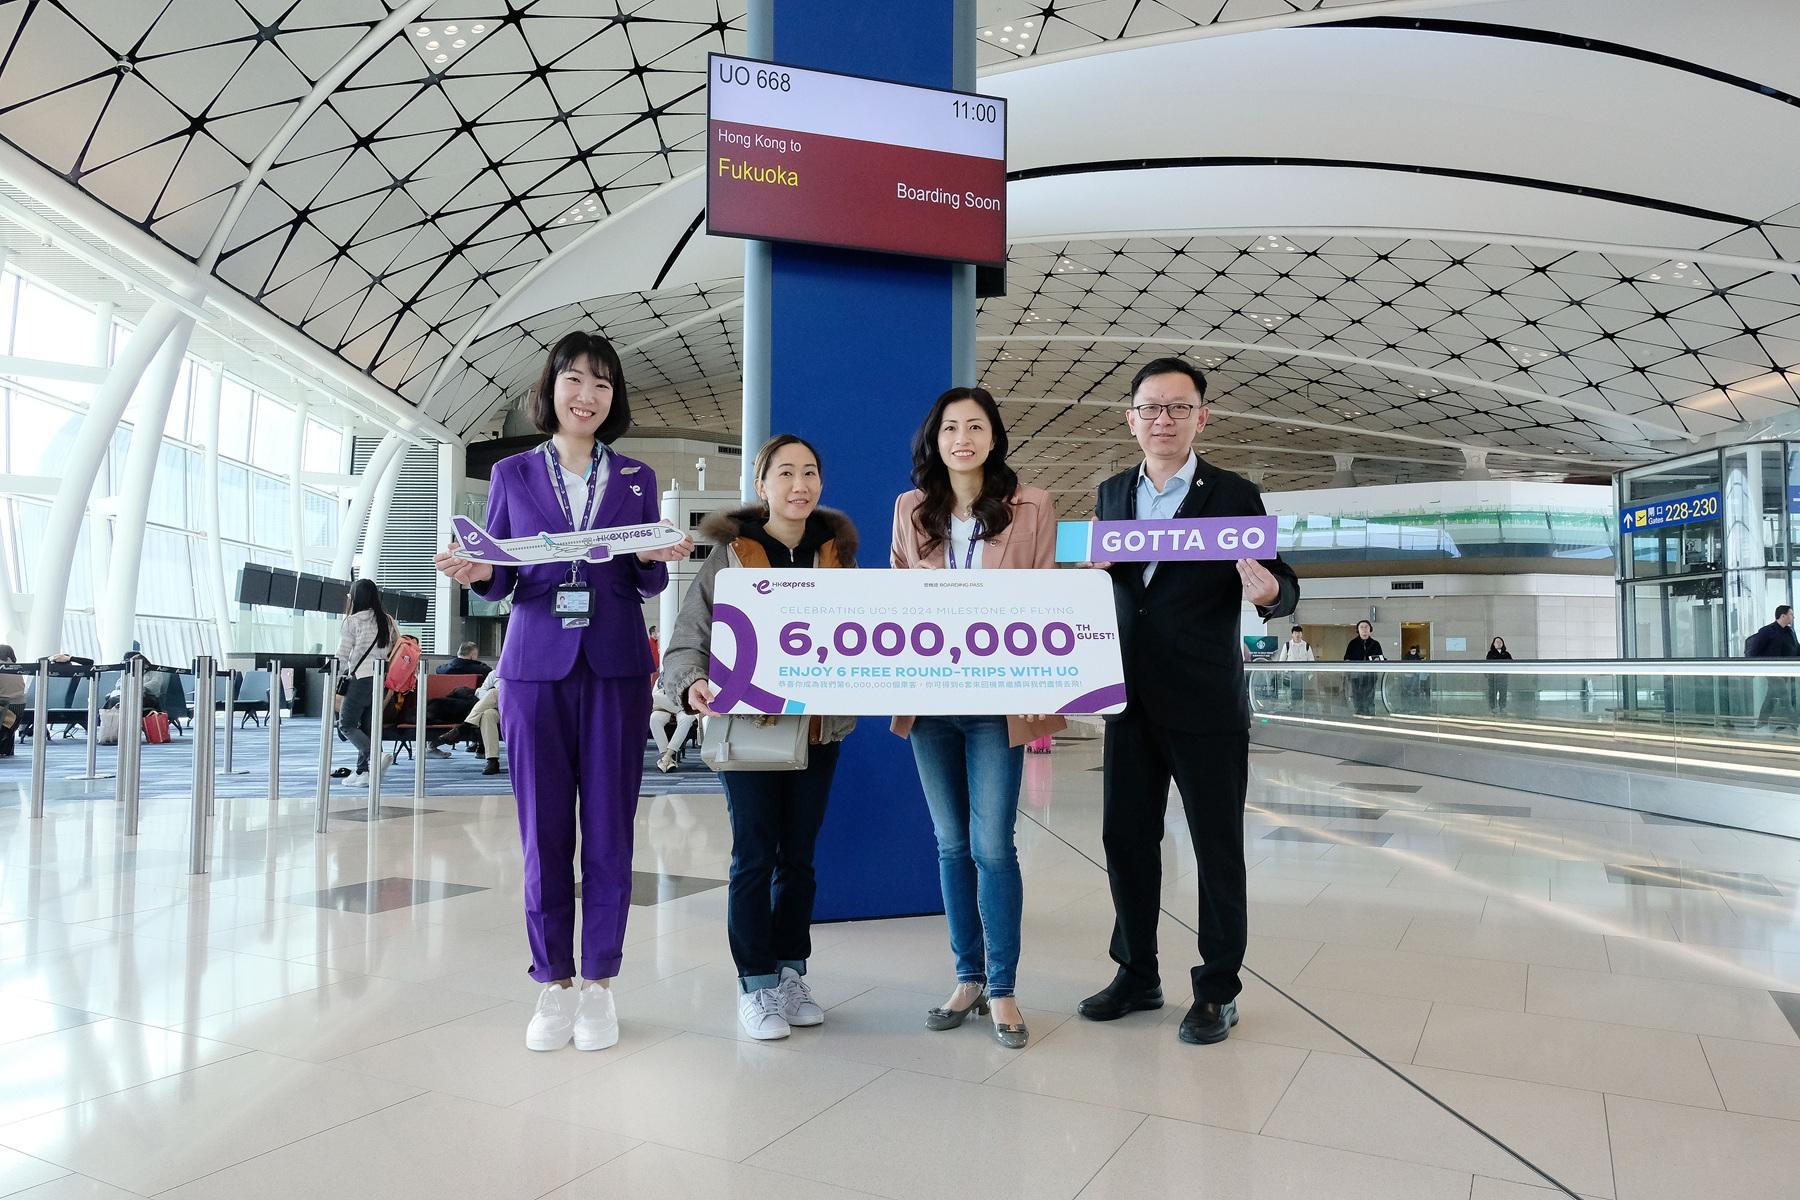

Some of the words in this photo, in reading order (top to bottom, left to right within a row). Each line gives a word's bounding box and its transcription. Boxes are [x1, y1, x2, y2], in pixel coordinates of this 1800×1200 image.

[719, 63, 750, 86] UO
[757, 69, 791, 92] 668
[952, 99, 997, 124] 11:00
[718, 128, 751, 149] Hong
[755, 133, 787, 154] Kong
[790, 139, 802, 153] to
[718, 157, 799, 187] Fukuoka
[897, 182, 960, 210] Boarding
[965, 191, 1001, 212] Soon
[1648, 517, 1664, 525] Gates
[1666, 497, 1717, 522] 228-230
[597, 528, 654, 542] HKexpress
[1102, 528, 1205, 552] GOTTA
[1217, 527, 1266, 550] GO
[772, 580, 815, 589] HKexpress
[780, 606, 865, 615] CELEBRATING
[870, 606, 898, 615] UO'S
[902, 606, 932, 615] 2024
[936, 606, 1006, 615] MILESTONE
[1010, 607, 1025, 615] OF
[1030, 606, 1075, 615] FLYING
[779, 621, 1076, 665] 6,000,000
[1077, 632, 1115, 640] GUEST!
[778, 666, 833, 677] ENJOY
[837, 666, 847, 677] 6
[851, 666, 890, 677] FREE
[895, 666, 1006, 677] ROUND-TRIPS
[1010, 666, 1051, 677] WITH
[1056, 666, 1079, 677] UO
